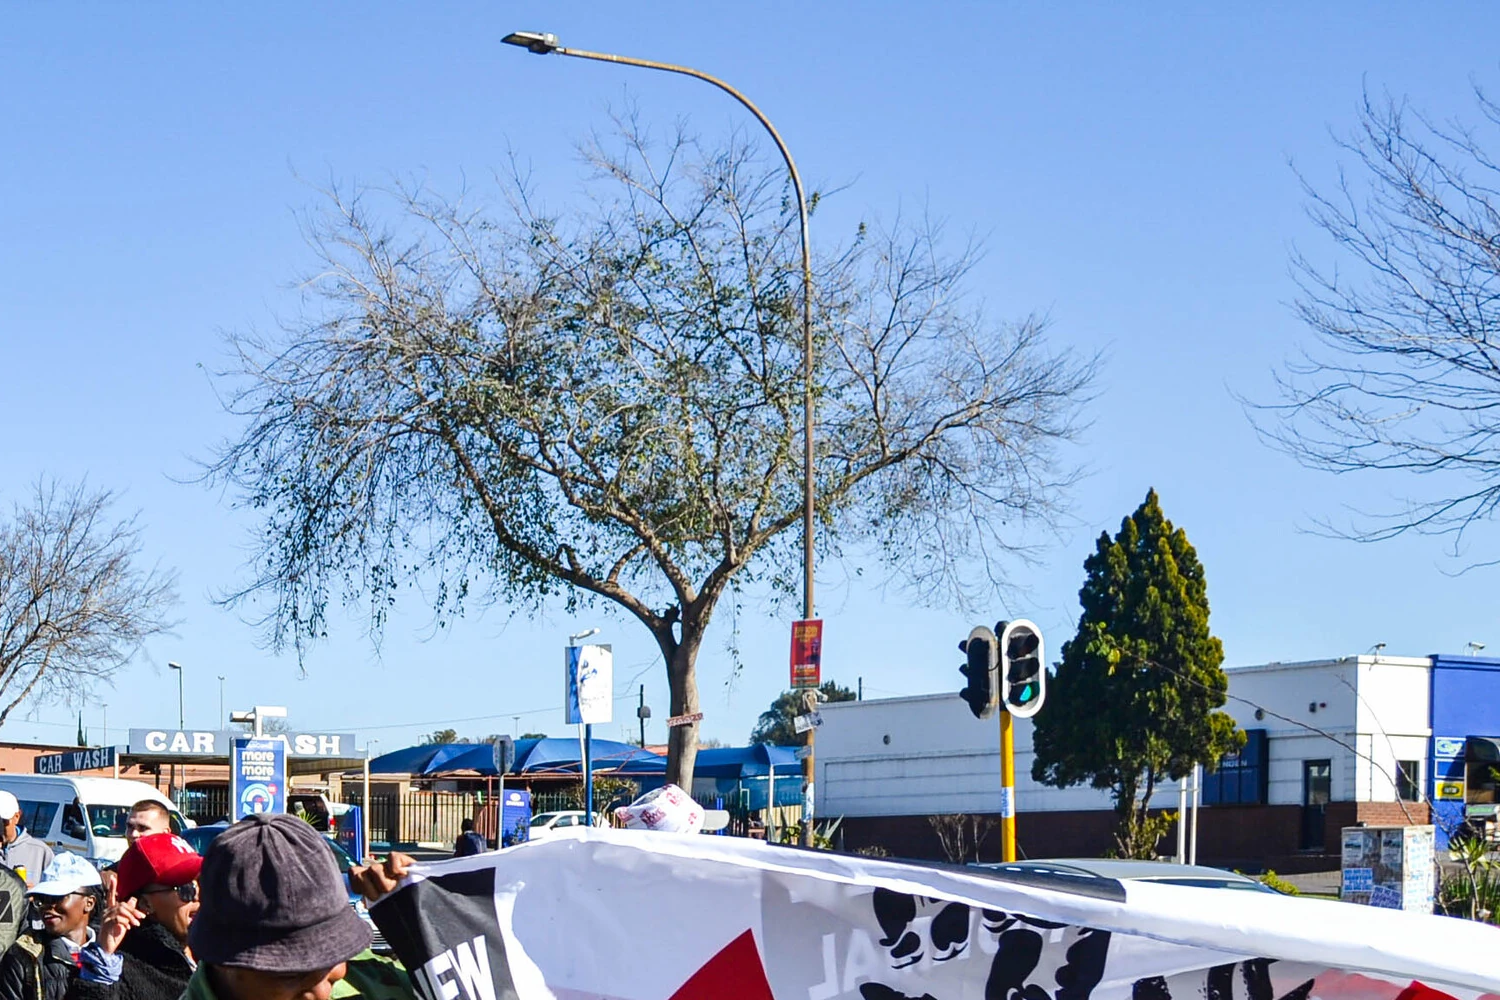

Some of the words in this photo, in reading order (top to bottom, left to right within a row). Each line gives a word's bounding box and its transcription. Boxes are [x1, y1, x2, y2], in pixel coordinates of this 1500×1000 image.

[145, 731, 214, 753] CAR
[40, 754, 63, 774] CAR
[73, 748, 109, 770] WASH
[241, 751, 275, 762] more
[241, 766, 275, 776] more
